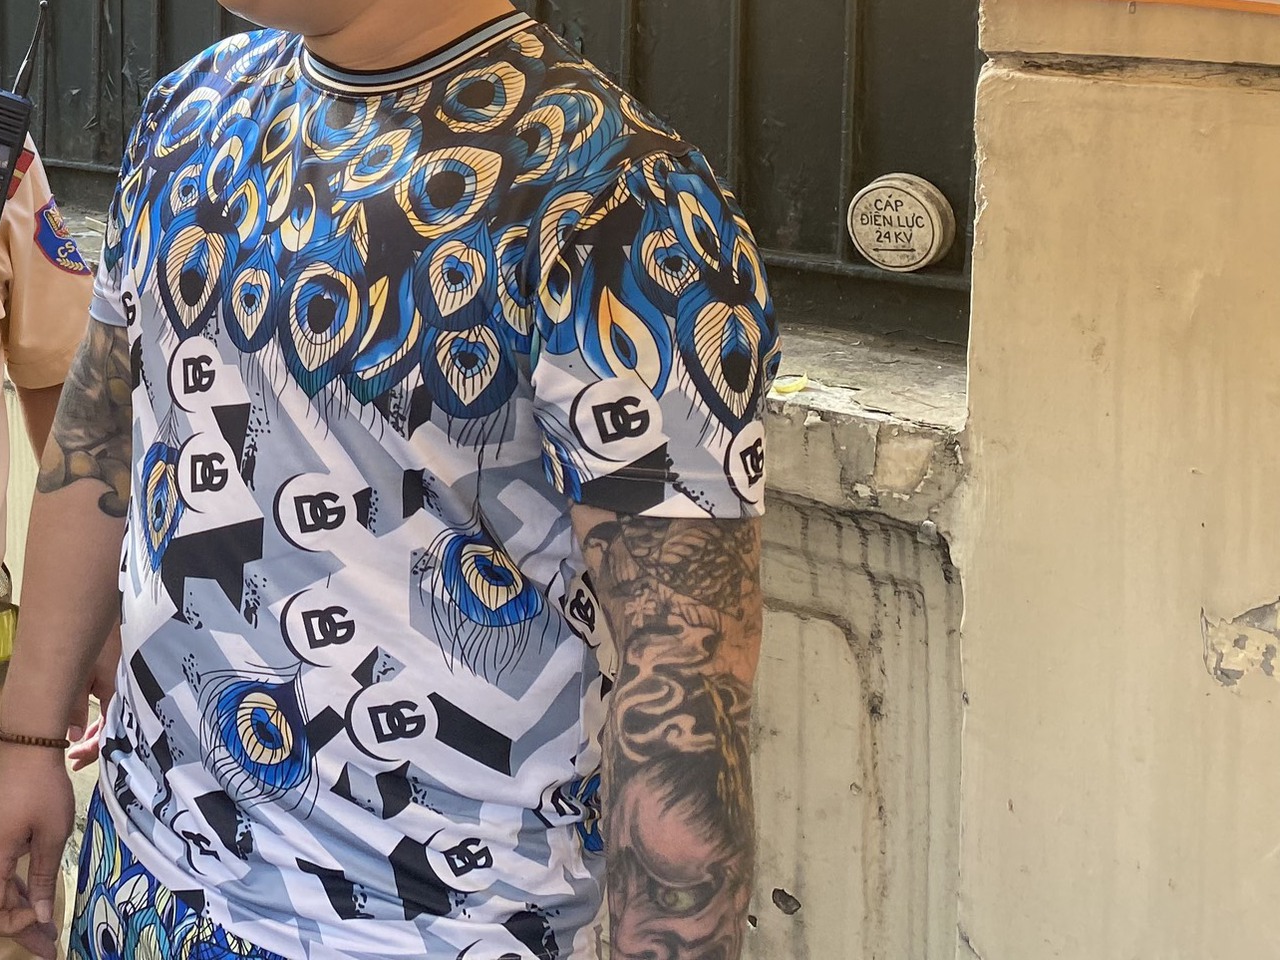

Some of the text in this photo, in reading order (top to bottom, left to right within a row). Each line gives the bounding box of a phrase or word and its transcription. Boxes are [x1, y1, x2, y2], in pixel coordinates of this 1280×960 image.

[874, 193, 904, 212] CÁP
[897, 212, 925, 232] LỰC
[57, 241, 76, 258] CS
[875, 230, 913, 243] 24 KV
[182, 355, 216, 395] DG
[591, 395, 650, 445] DG
[191, 452, 228, 493] DG
[293, 491, 346, 534] DG
[301, 605, 356, 650] DG
[367, 700, 426, 744] DG
[440, 837, 494, 878] DG
